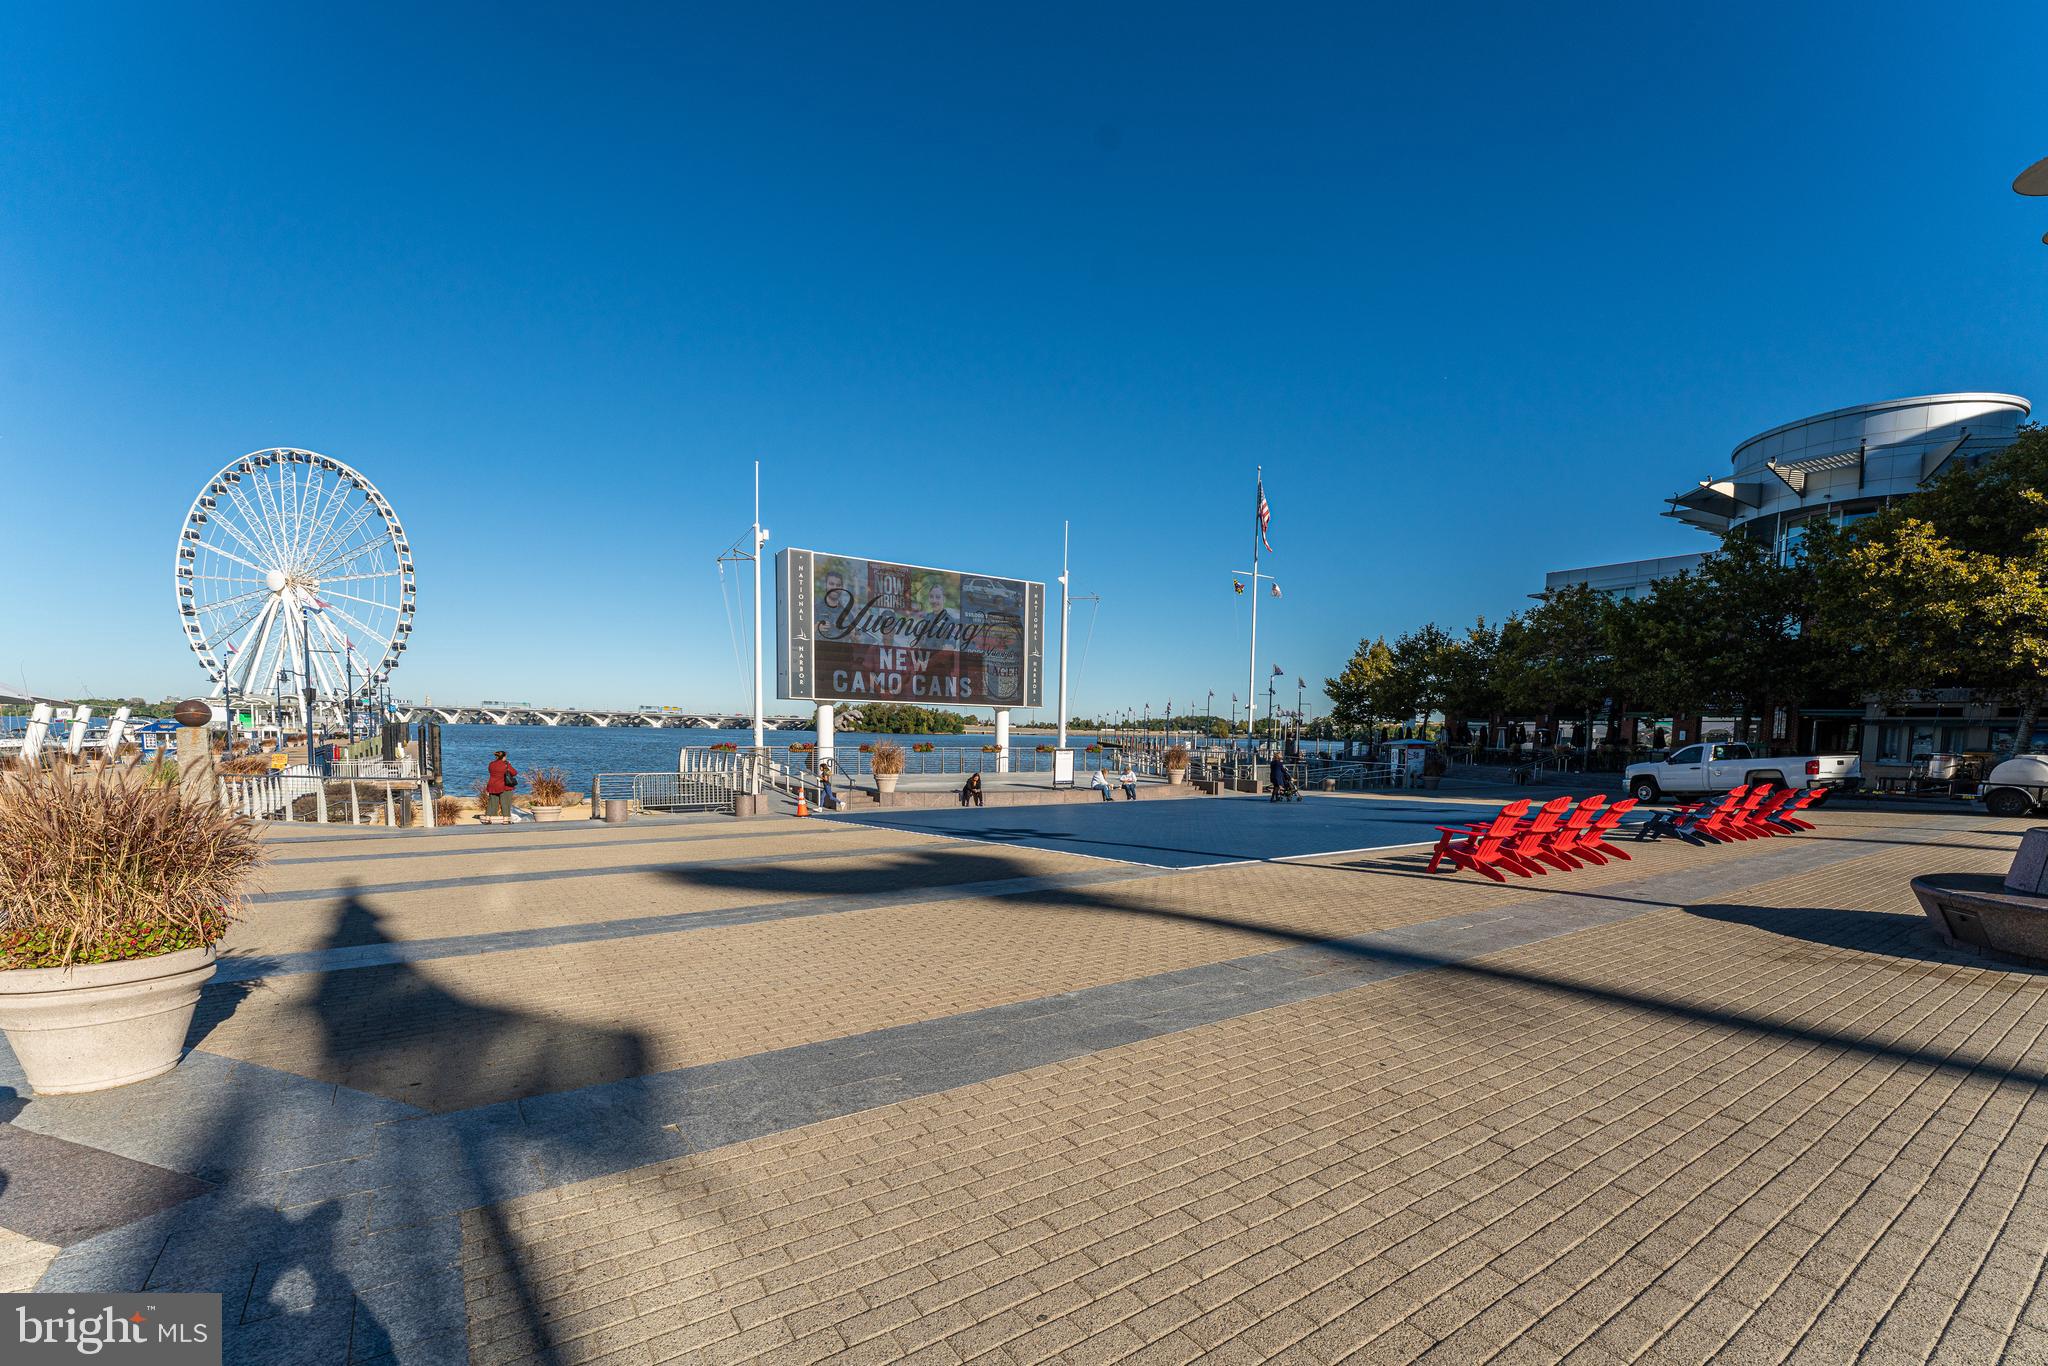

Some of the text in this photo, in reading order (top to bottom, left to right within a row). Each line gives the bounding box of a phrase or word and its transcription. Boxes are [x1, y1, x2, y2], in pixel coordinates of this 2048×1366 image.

[874, 575, 904, 595] NOW
[817, 588, 984, 652] Yuengling
[879, 648, 931, 672] NEW
[833, 671, 972, 698] CAMO CANS
